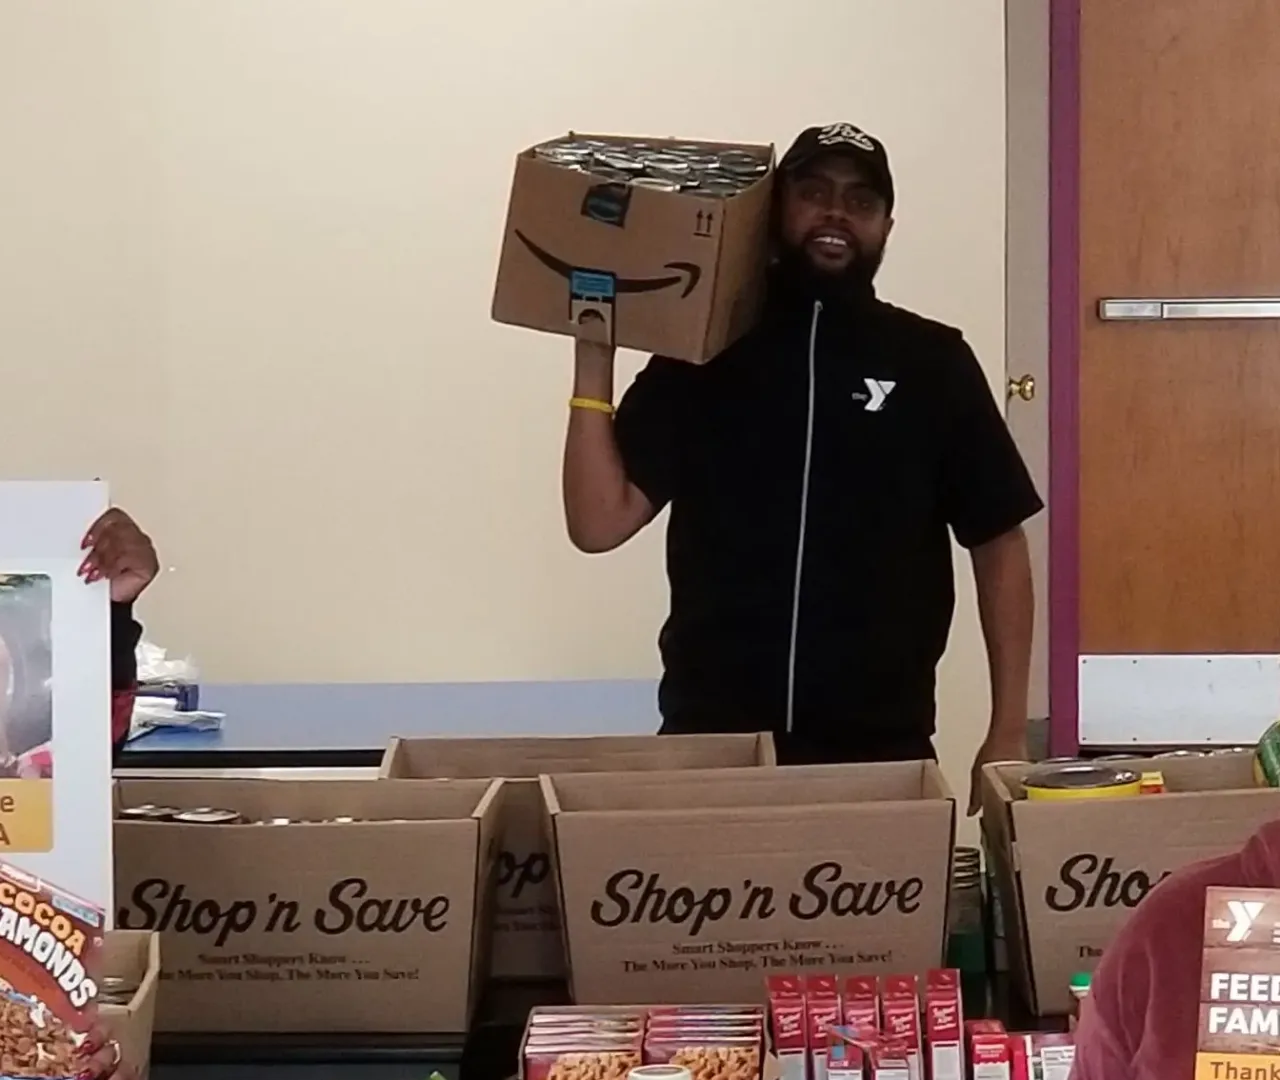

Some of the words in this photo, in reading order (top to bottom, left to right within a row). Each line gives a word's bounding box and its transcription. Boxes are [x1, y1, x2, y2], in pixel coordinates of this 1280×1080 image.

[789, 861, 924, 920] Save
[1045, 854, 1173, 912] Sho
[314, 878, 451, 935] Save
[1227, 901, 1265, 942] Y
[199, 953, 240, 965] Smart
[242, 953, 306, 968] Shoppers
[622, 960, 648, 973] The
[652, 958, 689, 971] More
[691, 957, 717, 970] You
[759, 955, 786, 968] The
[788, 953, 824, 967] More
[827, 952, 854, 965] You
[857, 950, 893, 964] Save!
[672, 943, 714, 956] Smart
[717, 940, 781, 956] Shoppers
[177, 969, 214, 981] More
[217, 968, 243, 981] You
[286, 968, 313, 981] The
[315, 968, 350, 981] More
[355, 968, 380, 981] You
